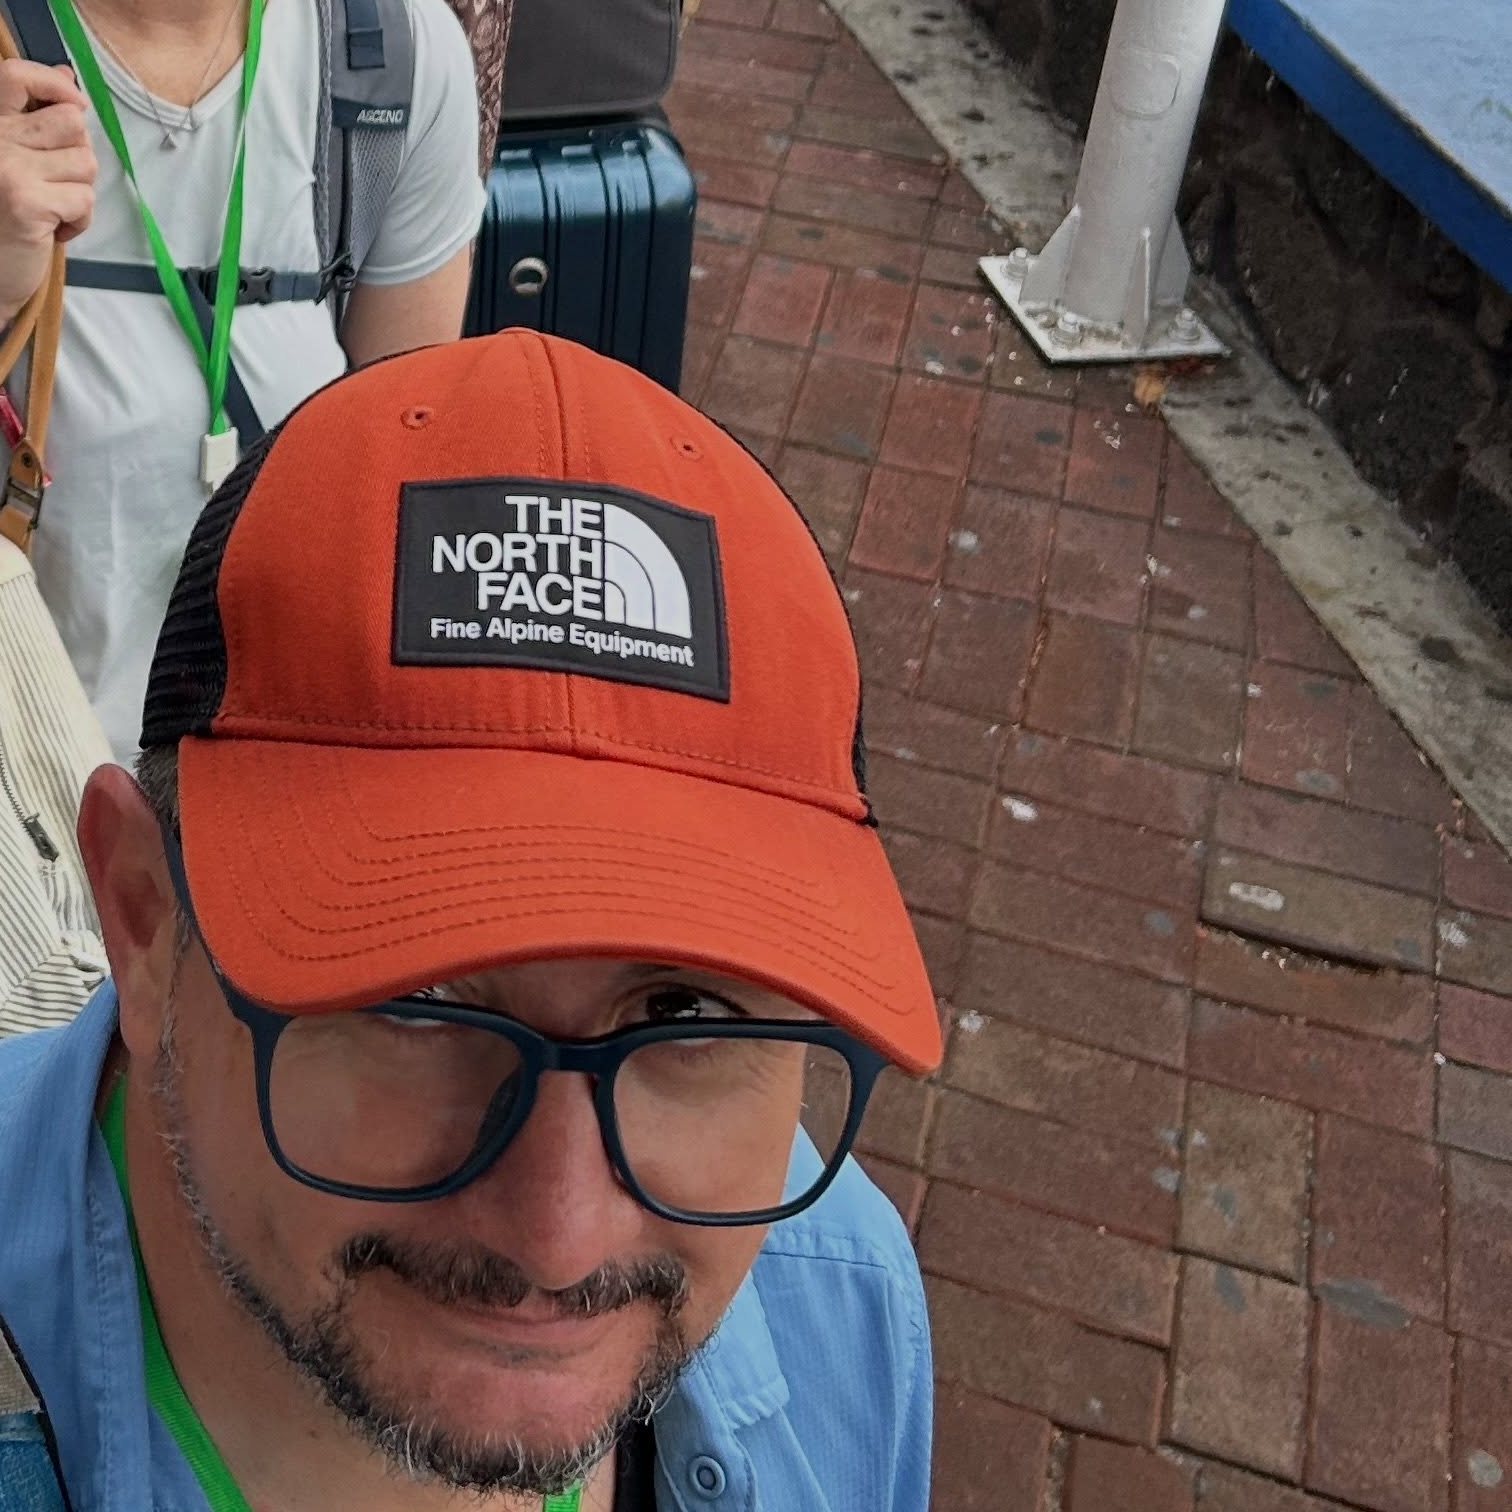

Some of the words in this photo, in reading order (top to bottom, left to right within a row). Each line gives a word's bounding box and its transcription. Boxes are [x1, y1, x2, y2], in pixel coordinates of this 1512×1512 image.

[504, 495, 603, 540] THE
[432, 532, 603, 579] NORTH
[477, 571, 603, 621] FACE
[430, 617, 481, 639] Fine
[486, 617, 565, 643] Alpine
[569, 622, 695, 667] Equipment
